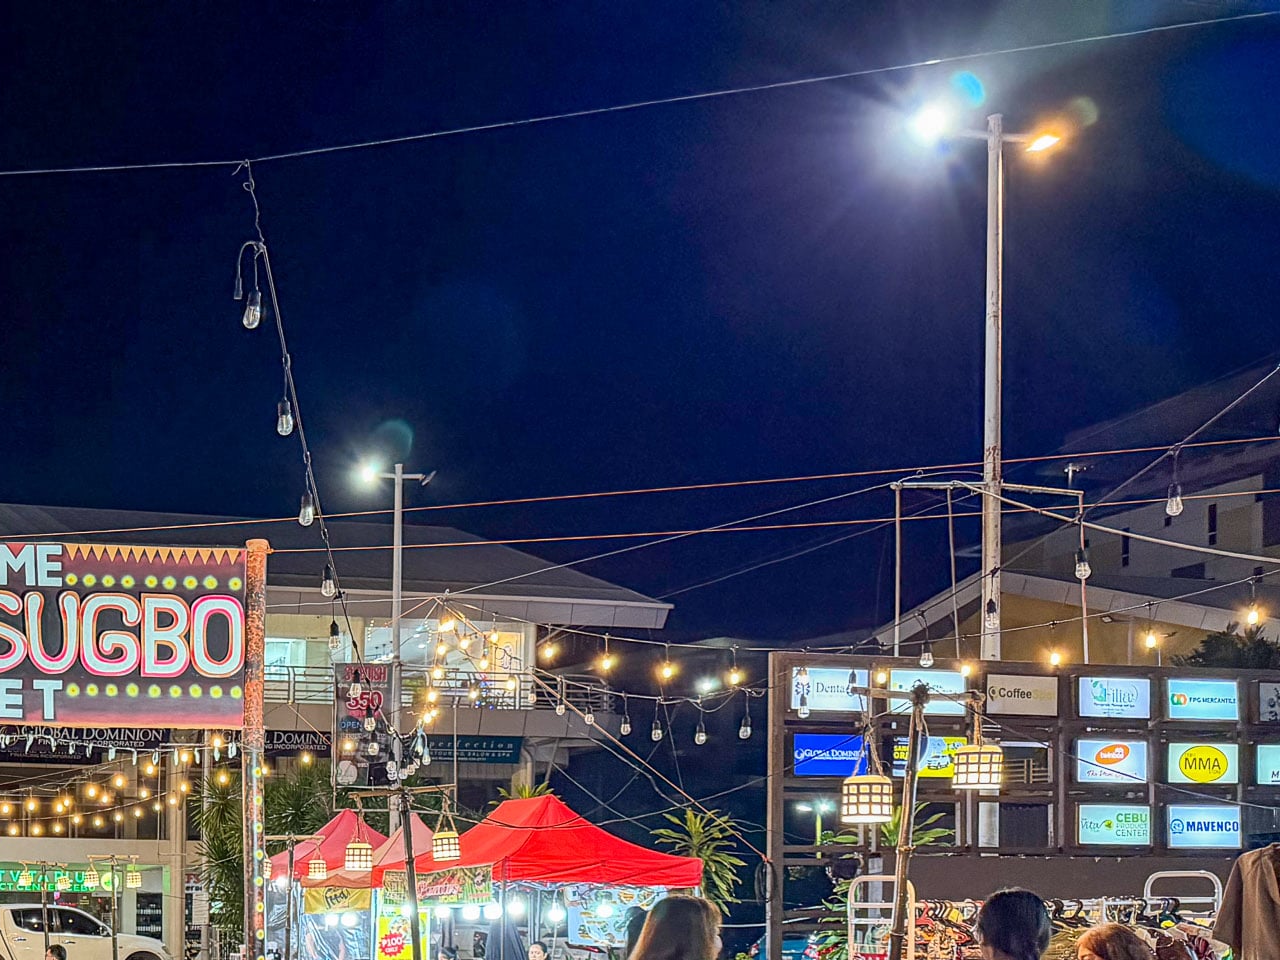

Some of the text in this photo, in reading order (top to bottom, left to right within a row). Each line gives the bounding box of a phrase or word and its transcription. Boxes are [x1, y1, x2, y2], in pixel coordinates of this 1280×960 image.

[82, 728, 163, 741] DOMINION
[273, 731, 331, 746] DOMINIO
[1184, 757, 1221, 770] MMA
[1116, 813, 1148, 823] CEBU
[1115, 829, 1148, 837] CENTER
[1187, 821, 1239, 832] MAVENCO
[9, 869, 50, 883] VTA
